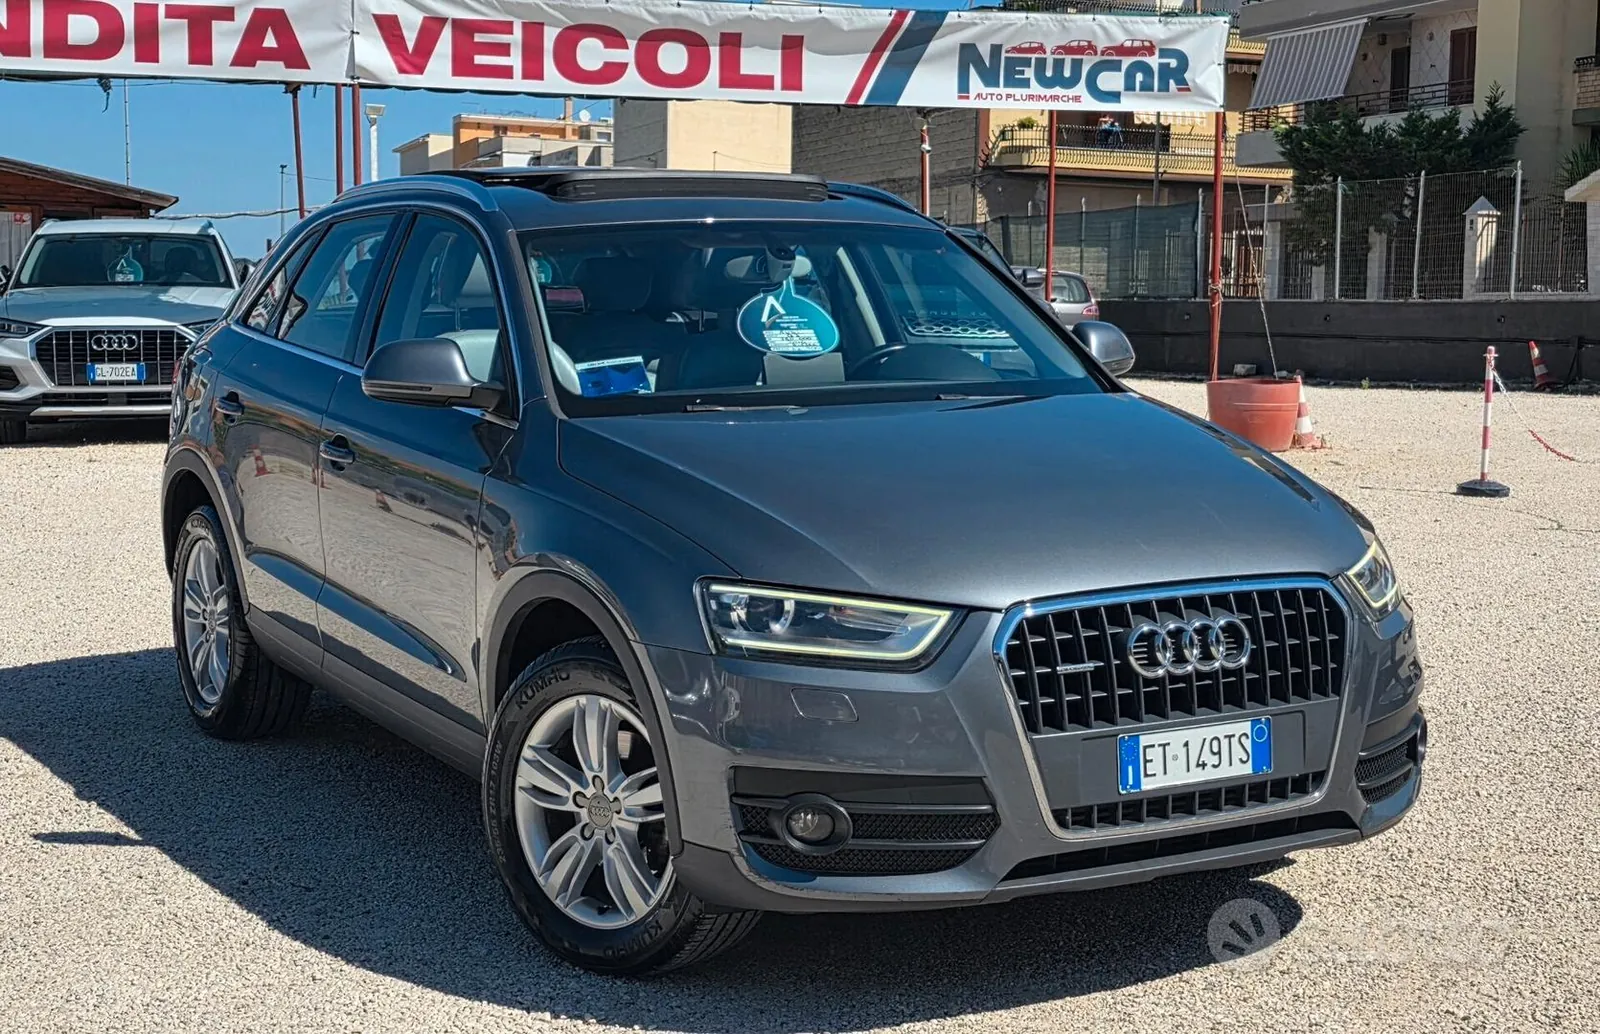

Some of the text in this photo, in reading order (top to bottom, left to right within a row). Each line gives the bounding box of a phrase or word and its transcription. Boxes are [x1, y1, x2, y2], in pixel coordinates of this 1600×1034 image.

[371, 13, 805, 92] VEICOLI
[974, 92, 1082, 103] AUTO PLURIMARCHE
[109, 367, 137, 378] 702EA
[1142, 732, 1251, 779] ET 149TS
